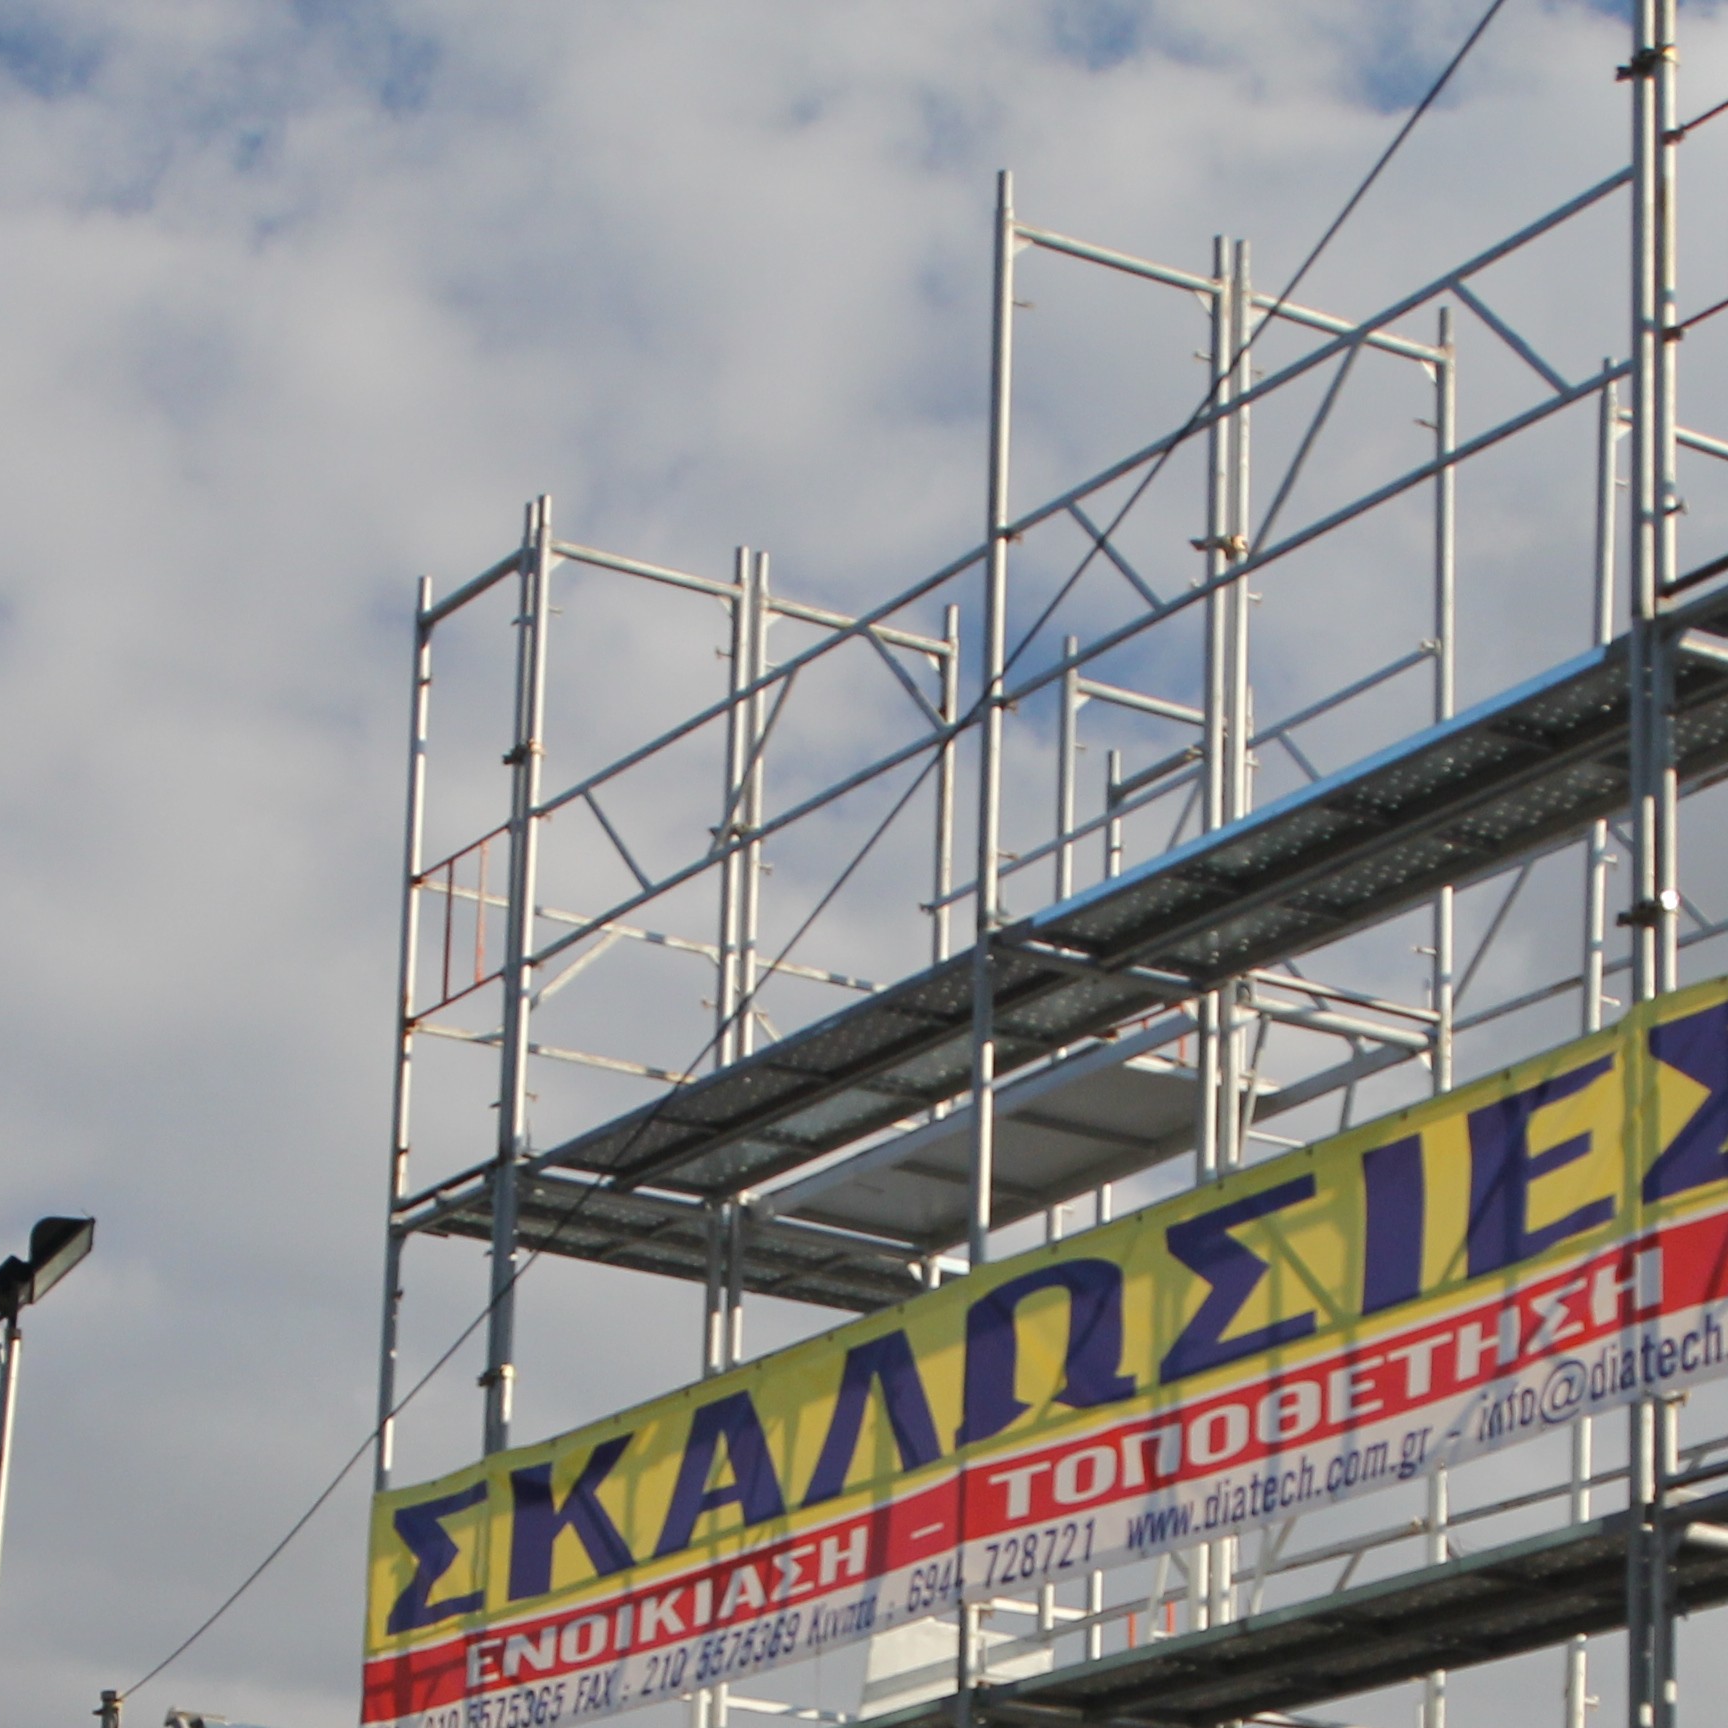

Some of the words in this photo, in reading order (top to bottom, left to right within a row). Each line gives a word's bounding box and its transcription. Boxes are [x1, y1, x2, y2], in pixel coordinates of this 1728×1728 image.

[466, 1525, 868, 1688] ΕΝΟΙΚΙΑΣΗ
[989, 1246, 1663, 1521] ΤΟΠΟΘΕΤΗΣΗ
[641, 1647, 688, 1695] 210
[985, 1516, 1096, 1589] 728721
[1127, 1427, 1433, 1551] www.diatech.com.gr
